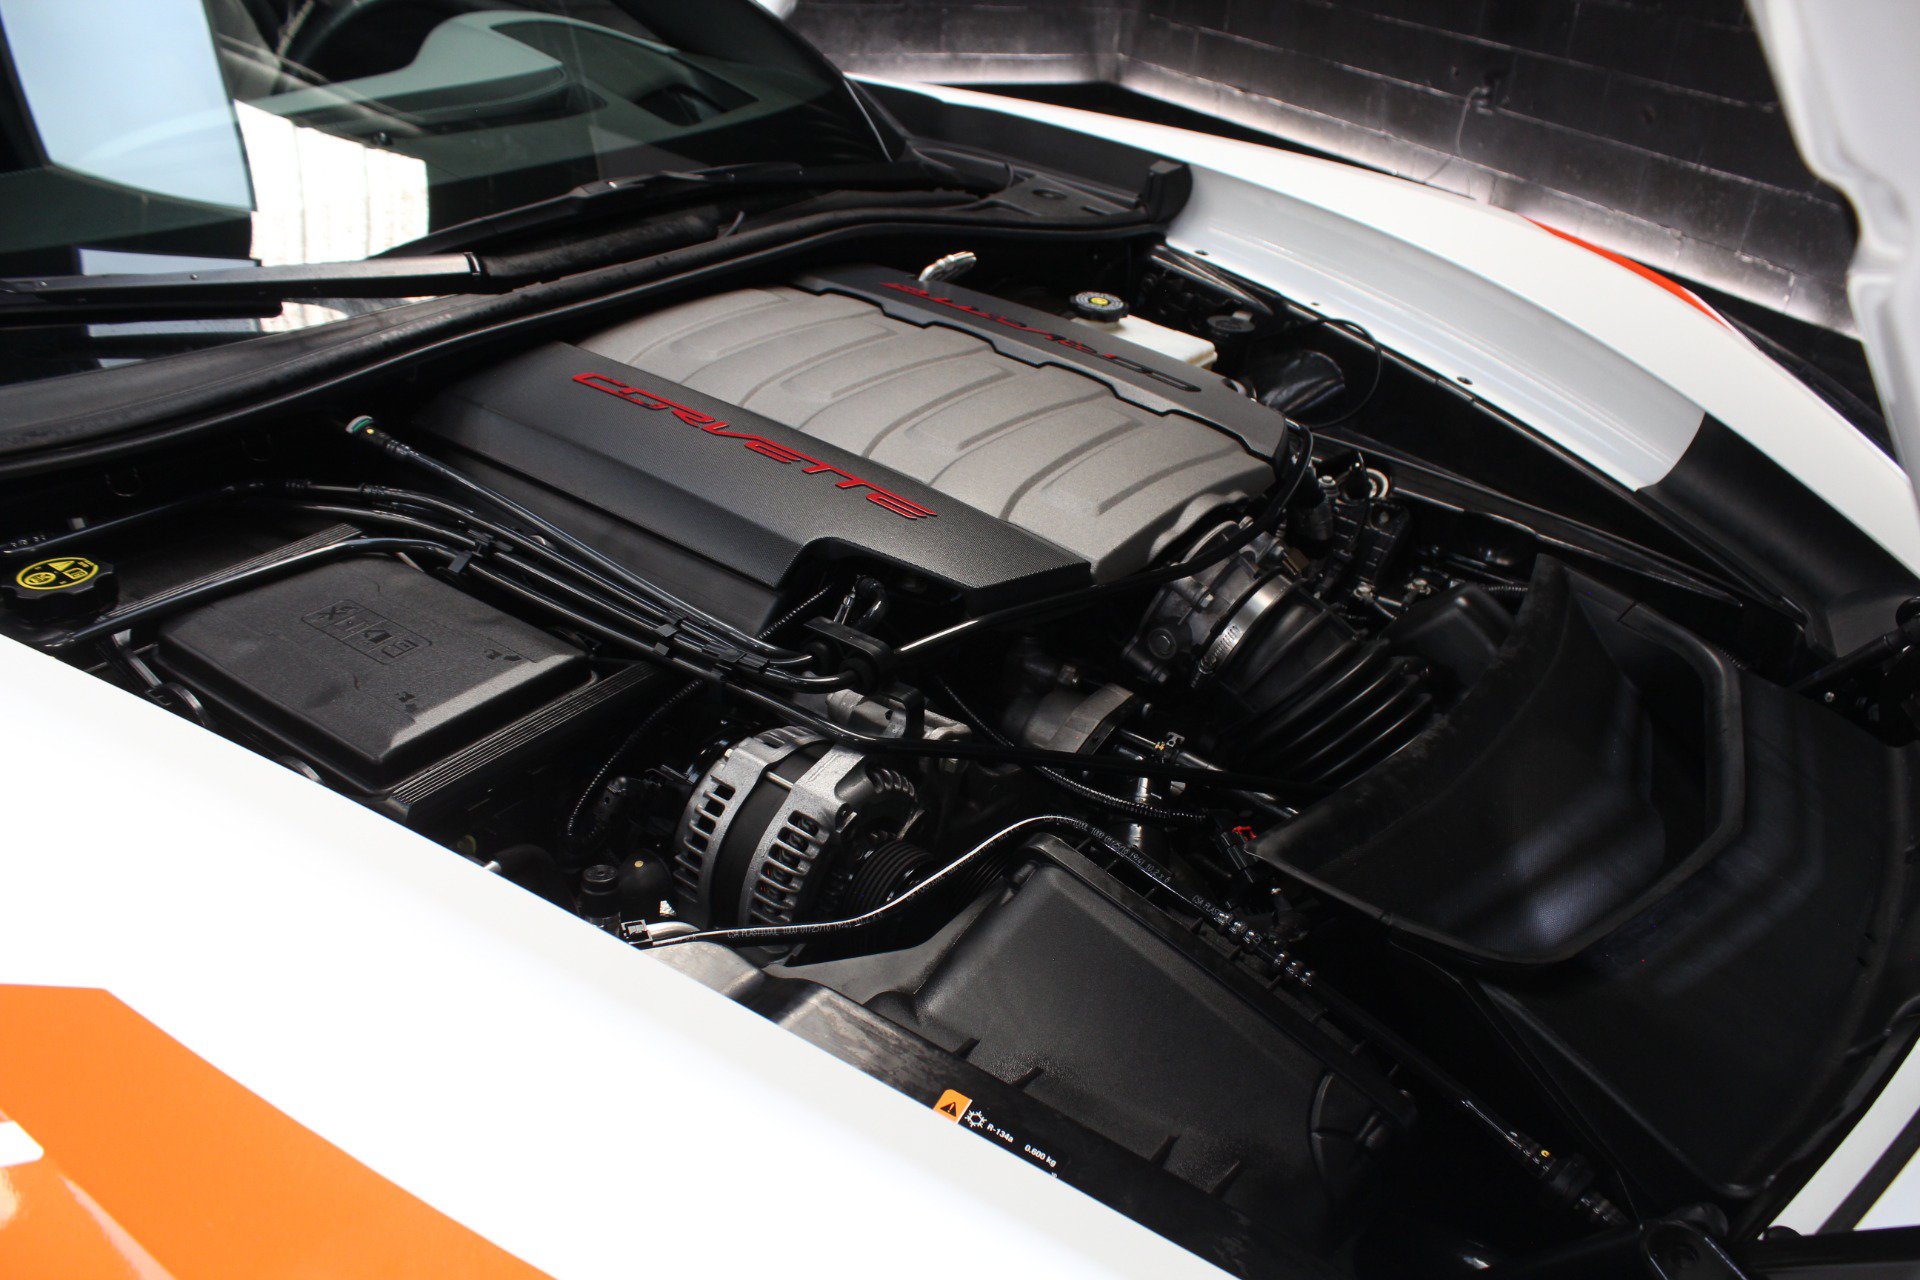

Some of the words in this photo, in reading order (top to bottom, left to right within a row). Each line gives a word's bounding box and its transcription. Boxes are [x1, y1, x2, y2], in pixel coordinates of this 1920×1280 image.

[880, 281, 1202, 392] CORVETTE
[572, 372, 938, 520] CORVETTE
[986, 1123, 1014, 1144] R-134a
[1024, 1144, 1046, 1161] 0.600
[1046, 1155, 1057, 1168] kg
